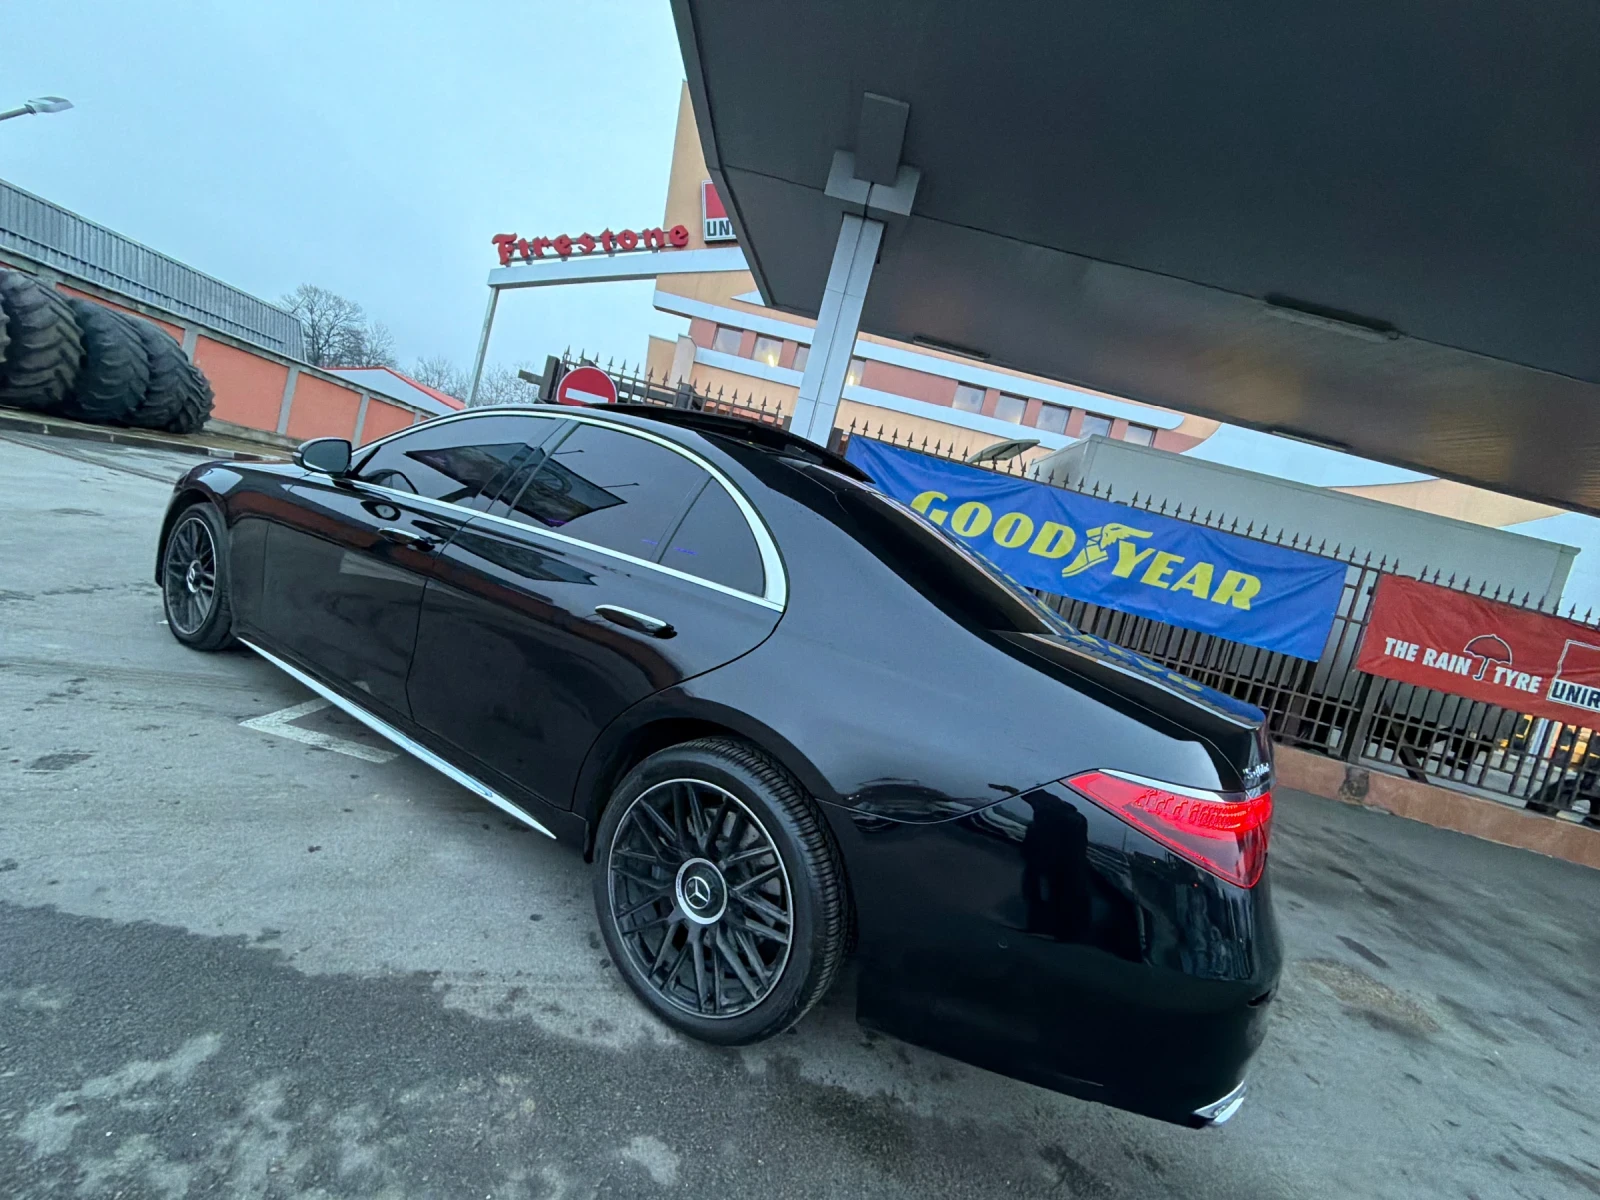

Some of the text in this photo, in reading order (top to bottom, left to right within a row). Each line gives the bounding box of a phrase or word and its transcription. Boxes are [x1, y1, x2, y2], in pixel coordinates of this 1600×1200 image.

[491, 224, 689, 266] Firestone
[1384, 637, 1543, 694] THE RAIN TYRE
